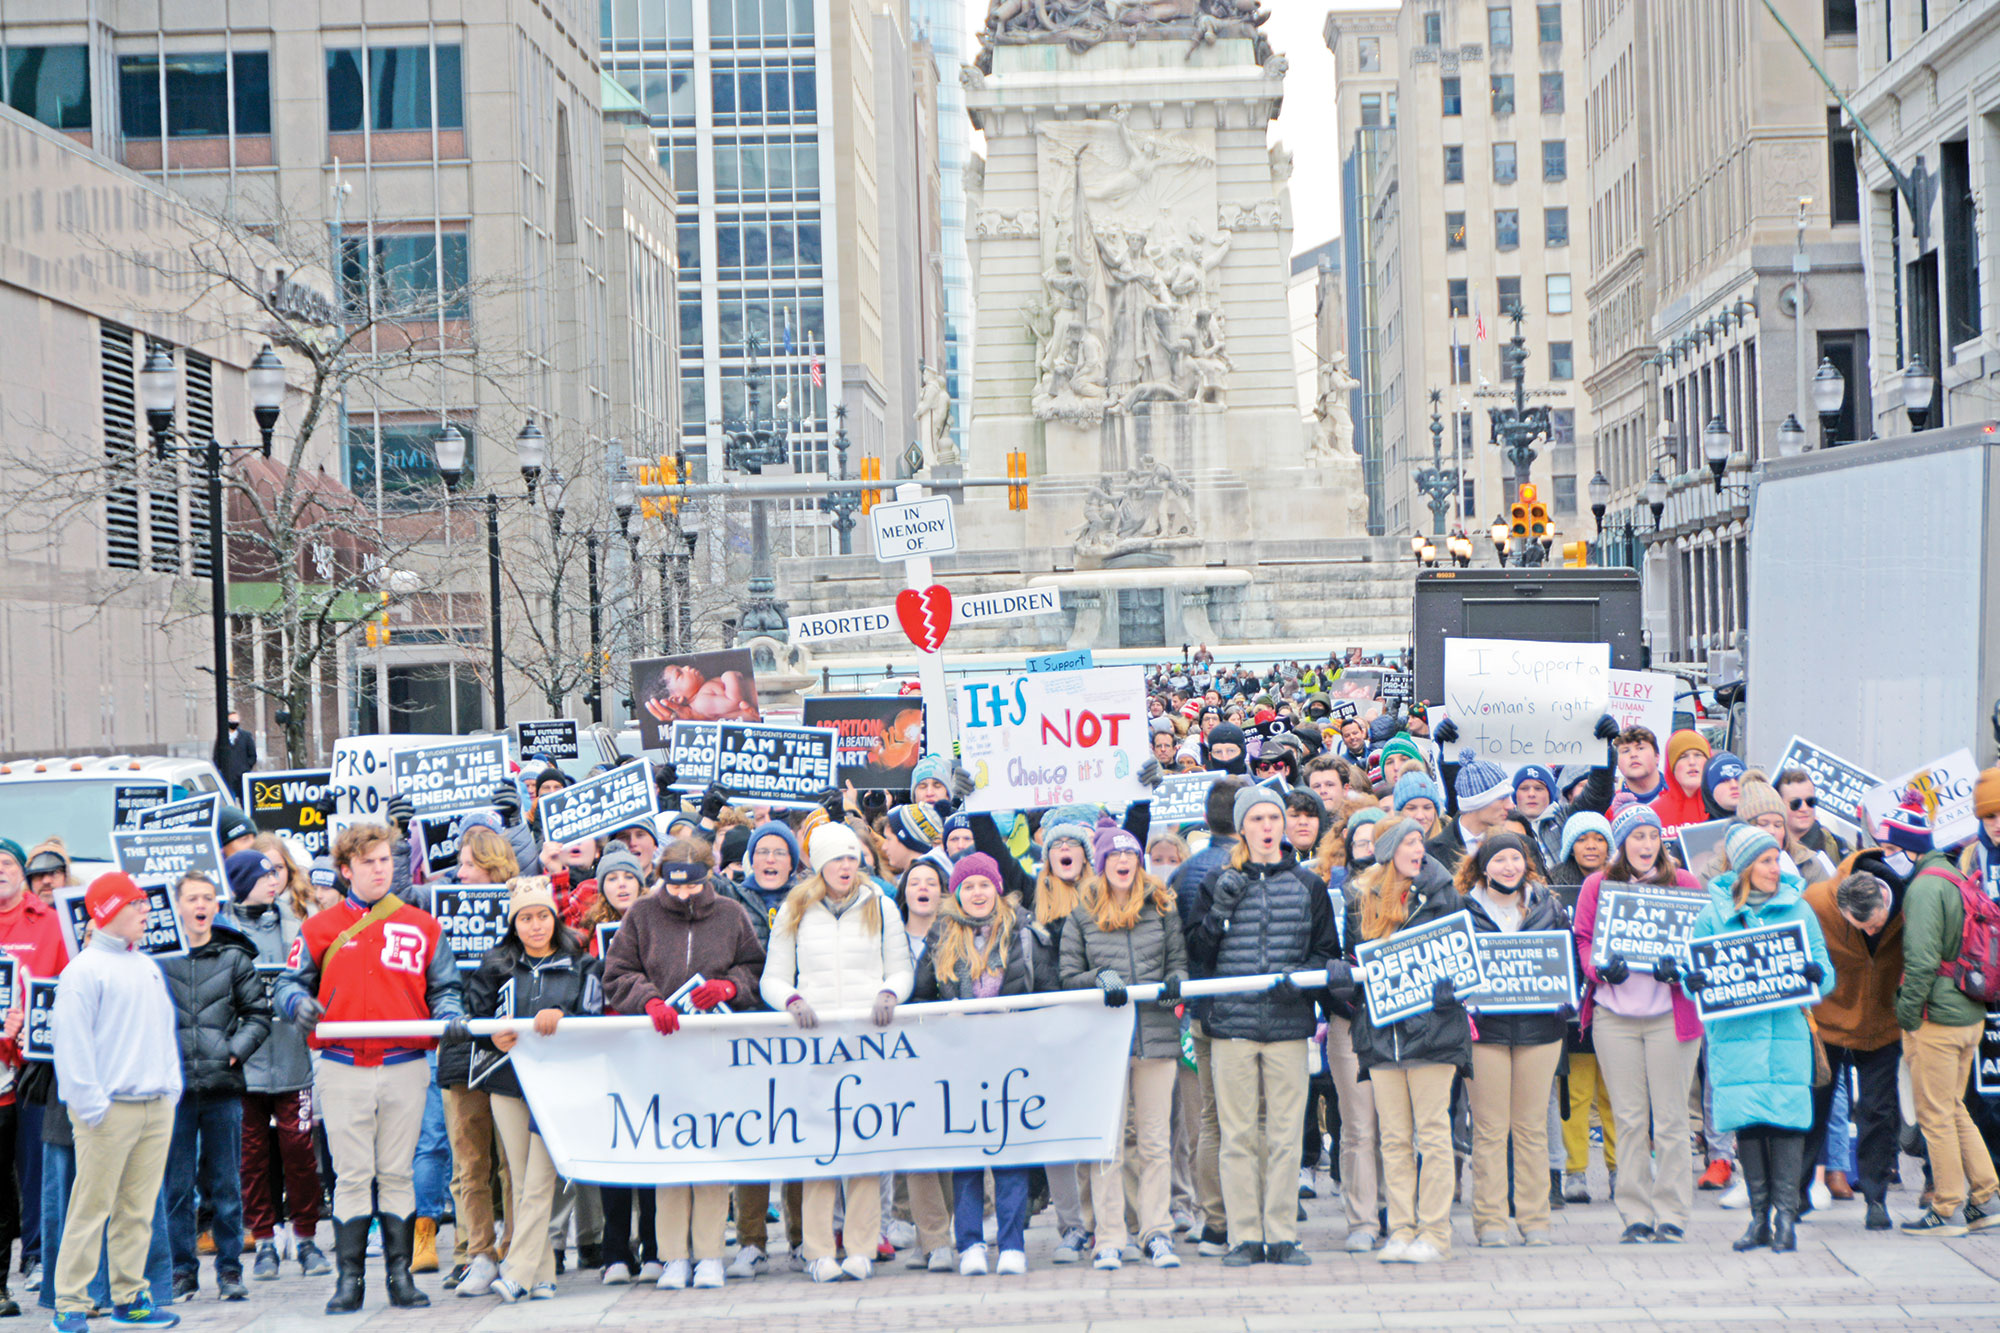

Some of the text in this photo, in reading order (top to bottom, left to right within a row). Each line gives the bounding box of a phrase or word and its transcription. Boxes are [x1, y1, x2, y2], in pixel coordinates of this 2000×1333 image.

[904, 508, 920, 520] IN
[882, 519, 945, 539] MEMORY
[906, 537, 924, 550] OF
[799, 592, 1053, 638] ABORTED CHILDREN
[1029, 654, 1086, 672] I Support
[1468, 649, 1600, 684] I Support a
[1451, 690, 1595, 721] Woman's right
[1612, 702, 1644, 712] HUMAN
[533, 735, 563, 745] ANTI-
[680, 733, 717, 746] I AM
[846, 736, 879, 747] BEATING
[1042, 708, 1131, 748] NOT
[1475, 723, 1583, 755] to be born
[521, 743, 577, 754] ABORTION
[727, 736, 824, 756] I AM THE
[336, 750, 387, 777] PRO-
[402, 750, 496, 774] I AM THE
[720, 752, 829, 776] PRO-LIFE
[1008, 756, 1067, 786] Choice
[1794, 749, 1802, 760] I
[1806, 757, 1835, 777] AM
[398, 764, 502, 793] PRO-LIFE
[550, 771, 639, 813] I AM THE
[721, 773, 826, 793] GENERATION
[1175, 781, 1212, 793] THE
[1890, 769, 1950, 803] TODD
[335, 785, 390, 814] PRO-
[547, 780, 647, 830] PRO-LIFE
[1035, 786, 1073, 805] Life
[552, 796, 647, 839] GENERATION
[123, 844, 208, 857] THE FUTURE IS
[144, 856, 194, 872] ANTI-
[442, 900, 490, 914] I AM
[1619, 905, 1625, 917] I
[1633, 907, 1666, 921] AM
[382, 923, 425, 973] R
[1382, 925, 1452, 955] STUDENTSFORLIFE.ORG
[1495, 947, 1559, 960] FUTURE IS
[1698, 937, 1796, 967] I AM THE
[1366, 931, 1469, 982] DEFUND
[1486, 960, 1542, 976] ANTI-
[1371, 951, 1473, 1001] PLANNED
[1475, 975, 1568, 993] BORTION
[1702, 972, 1808, 1005] GENERATION
[1375, 968, 1477, 1015] PARENTOD
[728, 1031, 919, 1068] INDIANA
[608, 1068, 1047, 1166] March for Life
